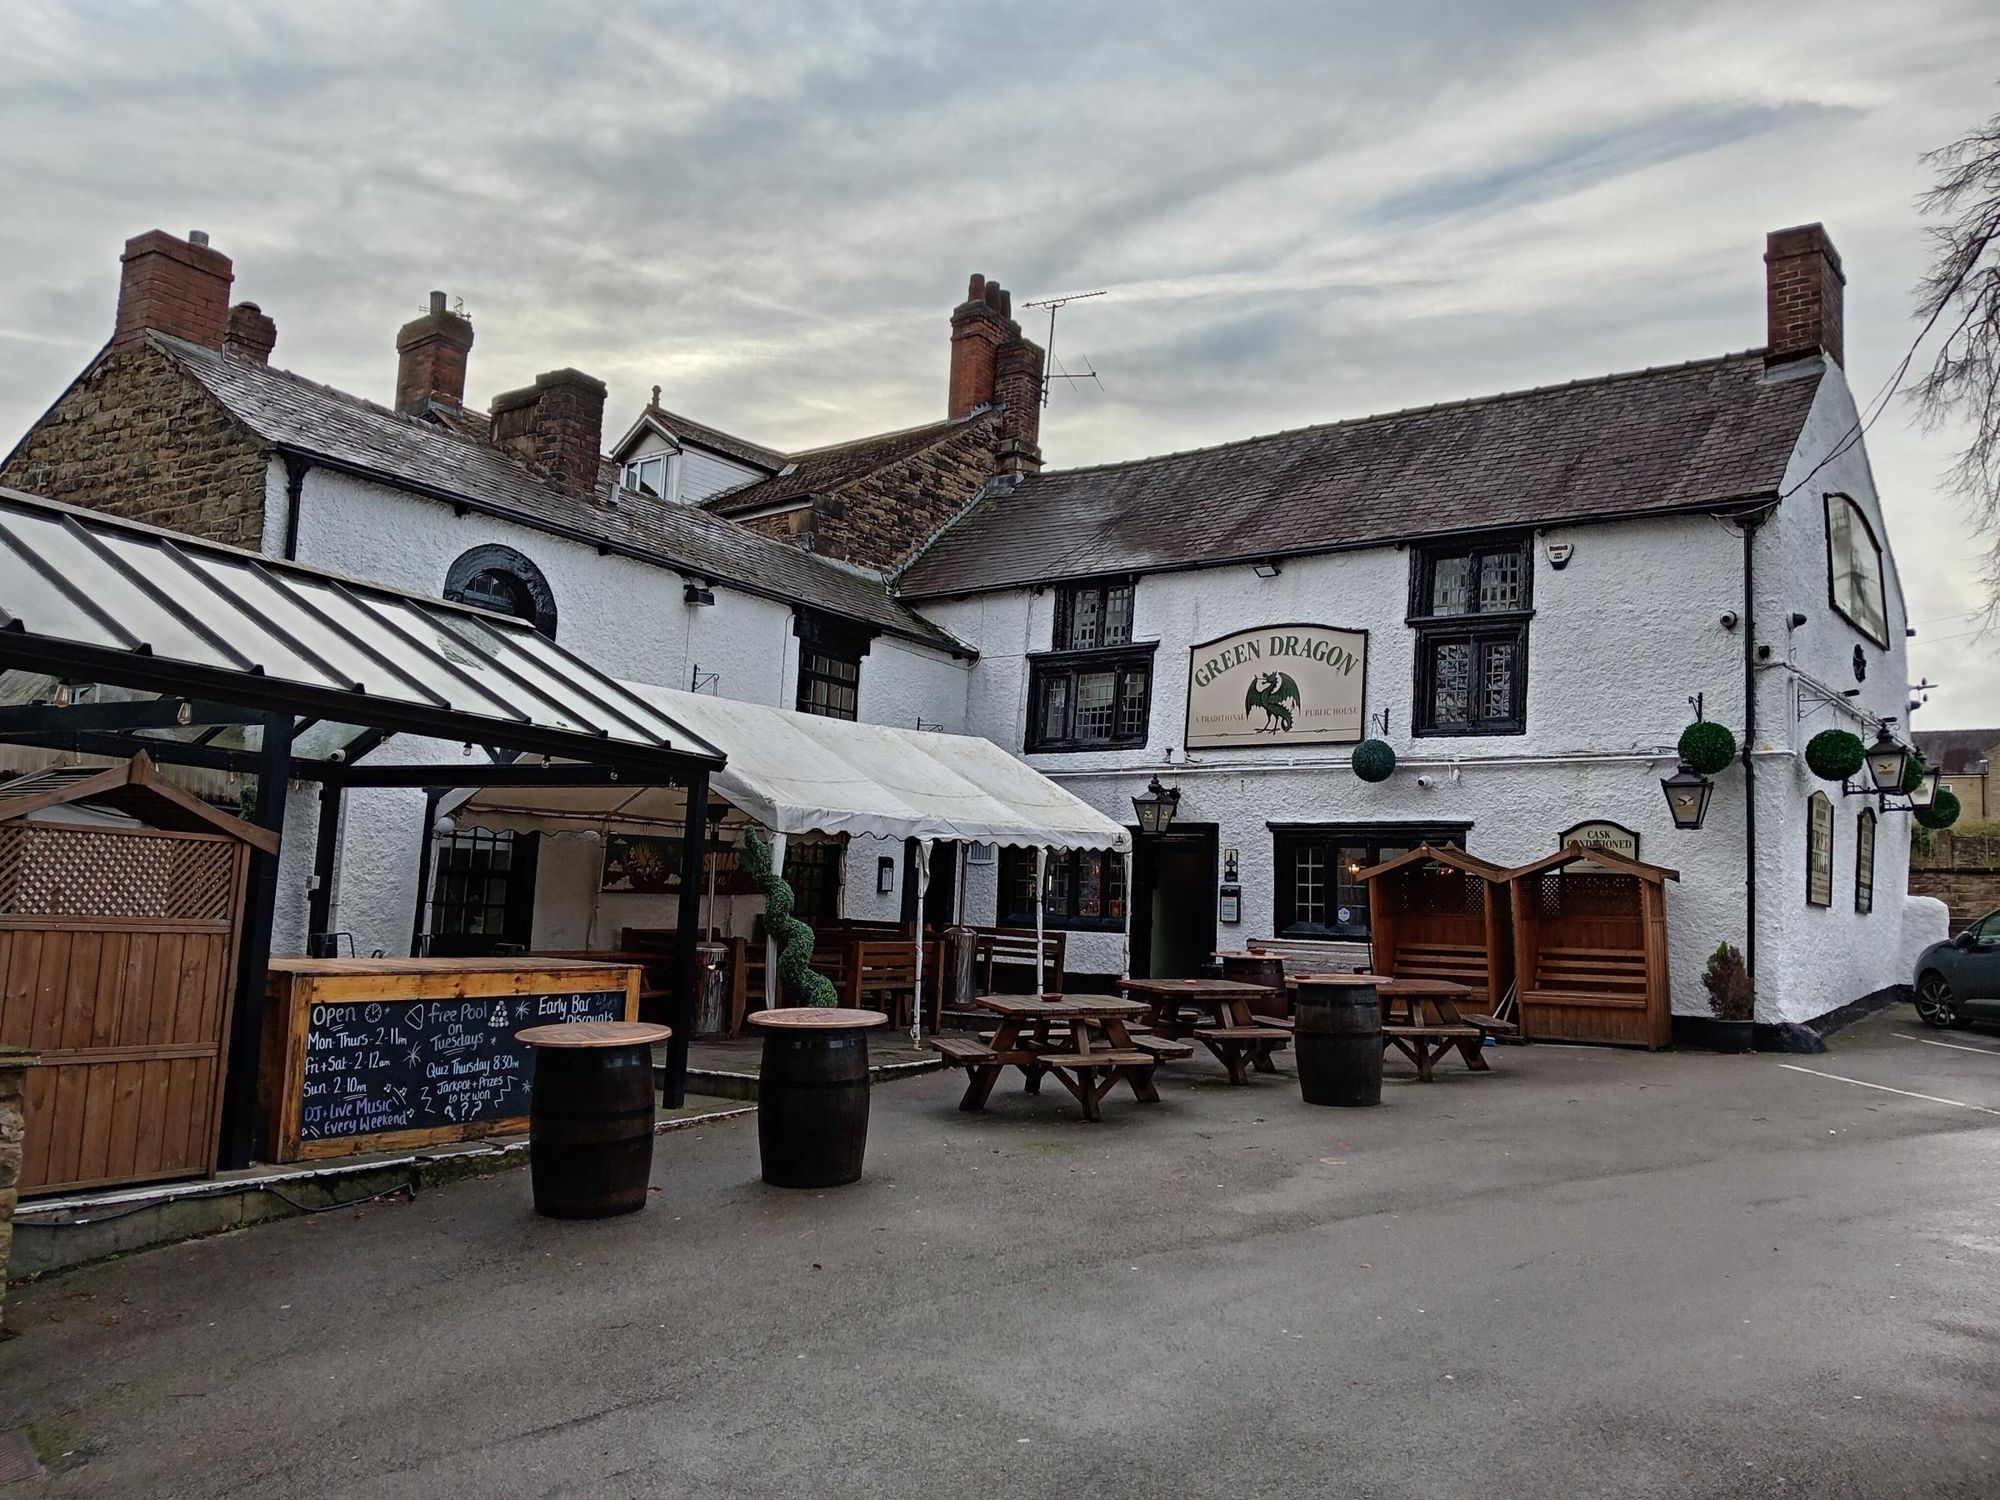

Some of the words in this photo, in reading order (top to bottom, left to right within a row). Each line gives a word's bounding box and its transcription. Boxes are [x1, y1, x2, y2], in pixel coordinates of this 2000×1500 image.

[1194, 639, 1261, 687] GREEN
[1269, 635, 1360, 677] DRAGON
[1201, 713, 1246, 723] TRADITIONAL
[1305, 708, 1332, 717] PUBLIC
[1332, 706, 1359, 716] HOUSE
[1587, 830, 1612, 839] CASK
[312, 1005, 356, 1027] Open
[459, 1001, 487, 1022] Pool
[538, 996, 568, 1021] Early
[571, 994, 591, 1014] Bar
[430, 1032, 484, 1052] Tuesdays
[426, 1062, 449, 1078] Quiz
[451, 1057, 490, 1076] Thursday
[478, 1076, 503, 1091] Prizes
[355, 1097, 393, 1115] Music
[448, 1093, 458, 1104] to
[460, 1091, 471, 1102] be
[472, 1089, 491, 1101] won
[323, 1117, 357, 1135] Every
[359, 1110, 408, 1132] Weekend
